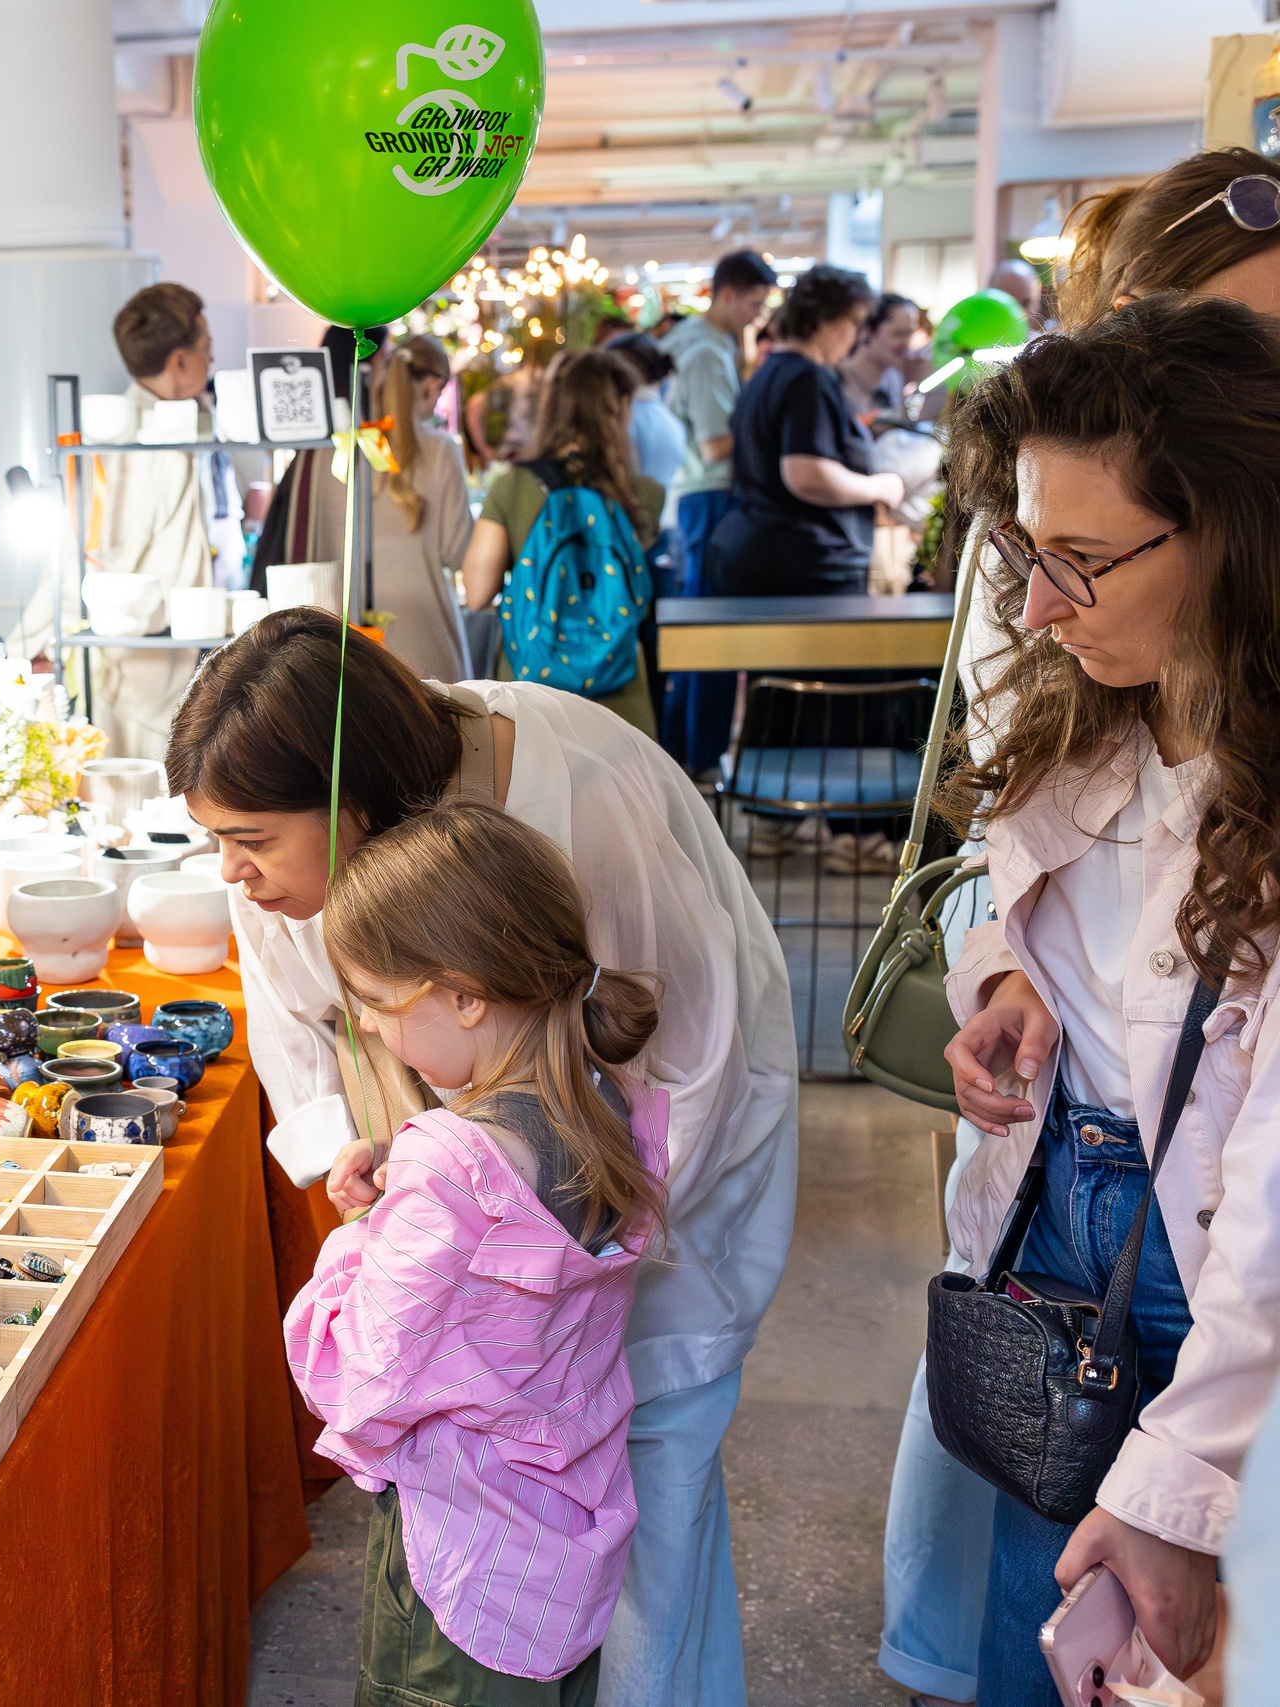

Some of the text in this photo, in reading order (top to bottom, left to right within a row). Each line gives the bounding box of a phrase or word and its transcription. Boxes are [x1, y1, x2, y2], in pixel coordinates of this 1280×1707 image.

[411, 107, 512, 132] GROWBOX
[365, 131, 475, 154] GROWBOX
[484, 134, 525, 157] лет
[413, 156, 508, 178] GROWBOX
